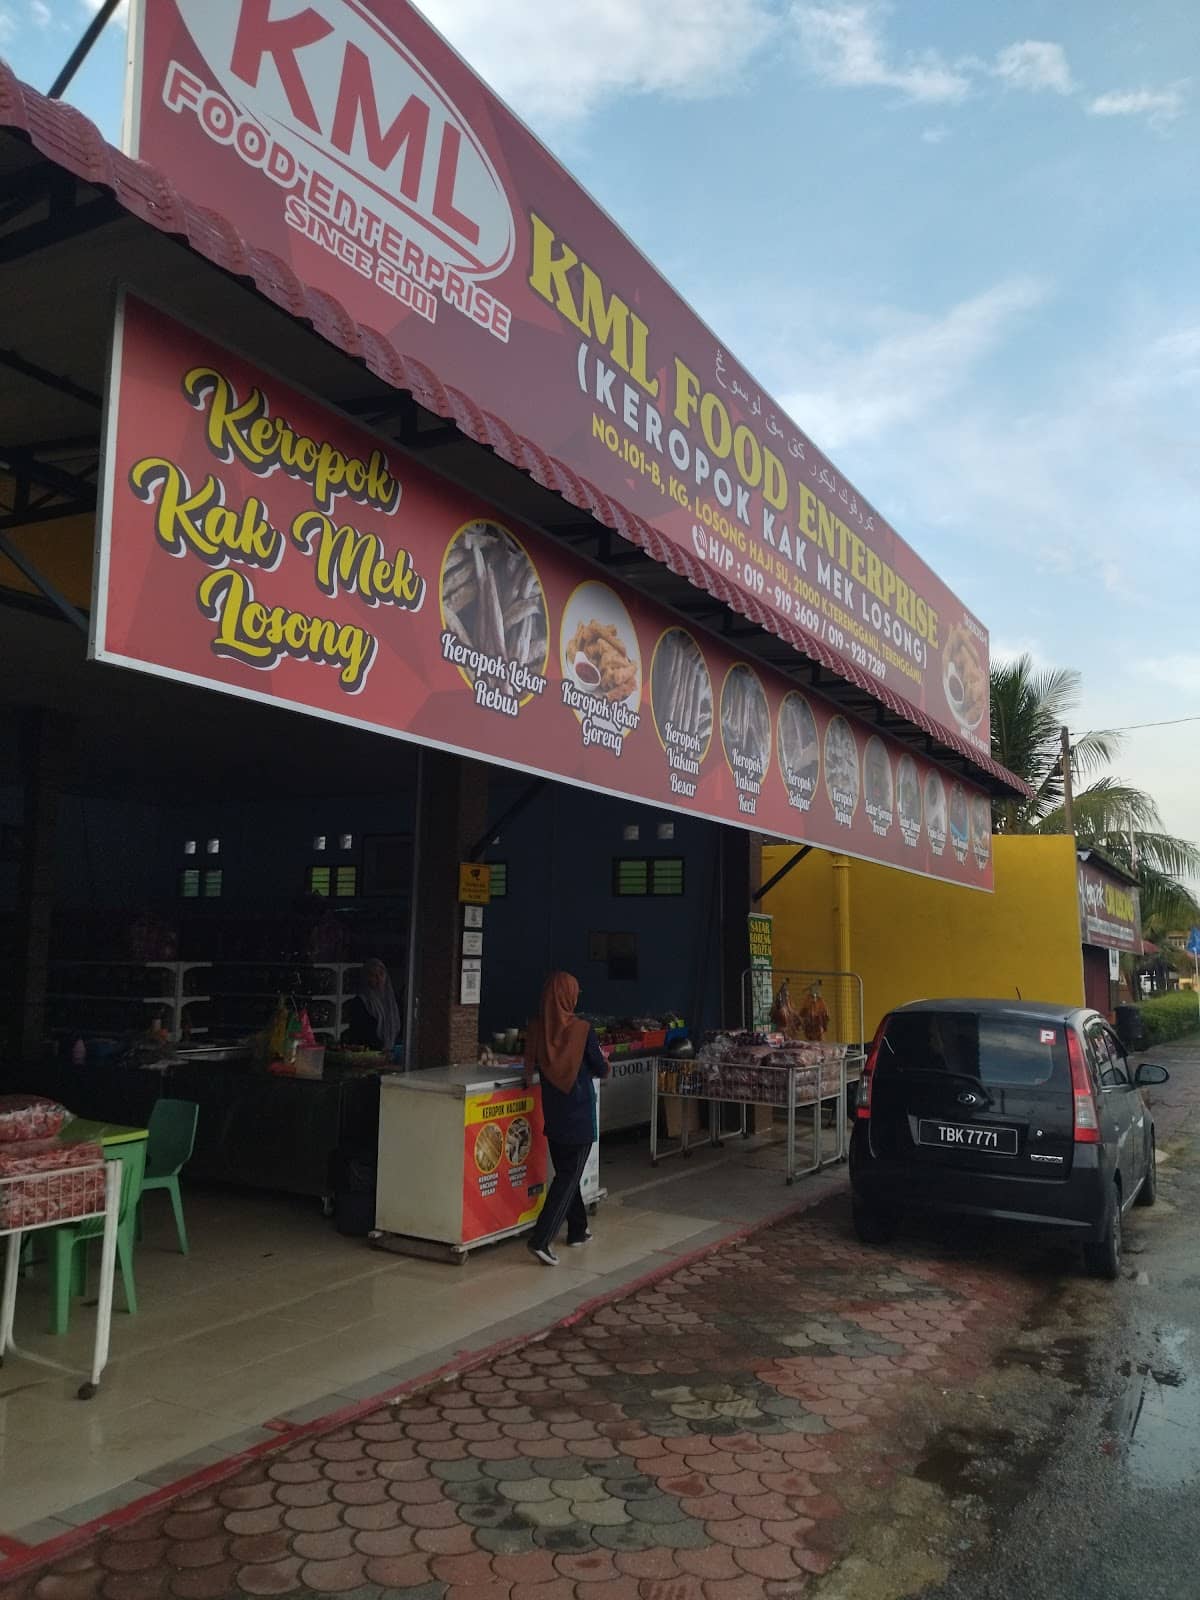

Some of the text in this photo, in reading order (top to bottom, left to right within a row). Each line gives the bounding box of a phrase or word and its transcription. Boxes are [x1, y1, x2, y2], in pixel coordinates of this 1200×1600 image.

[230, 0, 480, 246] KML
[162, 59, 511, 344] FOOD ENTERPRISE
[284, 195, 438, 325] SINCE 2001
[181, 367, 402, 516] Keropok
[528, 212, 939, 650] KML FOOD ENTERPRISE
[577, 342, 750, 527] (KEROPOK
[763, 507, 807, 573] KAK
[816, 553, 854, 609] MEK
[861, 591, 928, 669] LOSONG)
[129, 457, 427, 613] Kak Mek
[669, 475, 693, 512] KG.
[695, 495, 747, 553] LOSONG
[749, 539, 774, 576] HAJI
[793, 575, 821, 609] 21000
[198, 568, 379, 696] Losong
[709, 536, 734, 570] H/P
[743, 562, 765, 595] 019
[774, 585, 792, 619] 919
[794, 605, 820, 634] 3609
[828, 624, 844, 651] 019
[851, 640, 867, 666] 928
[866, 654, 887, 681] 7289
[441, 632, 547, 697] Keropok Lekor
[473, 680, 520, 718] Rebus
[561, 680, 641, 732] Keropok Lekor
[582, 716, 623, 757] Goreng
[664, 721, 701, 753] Keropok
[666, 747, 700, 776] Vakum
[732, 748, 762, 775] Keropok
[670, 773, 697, 798] Besar
[733, 770, 760, 795] Vakum
[738, 793, 757, 816] Kecil
[612, 1062, 643, 1078] FOOD
[938, 1126, 998, 1147] TBK 7771
